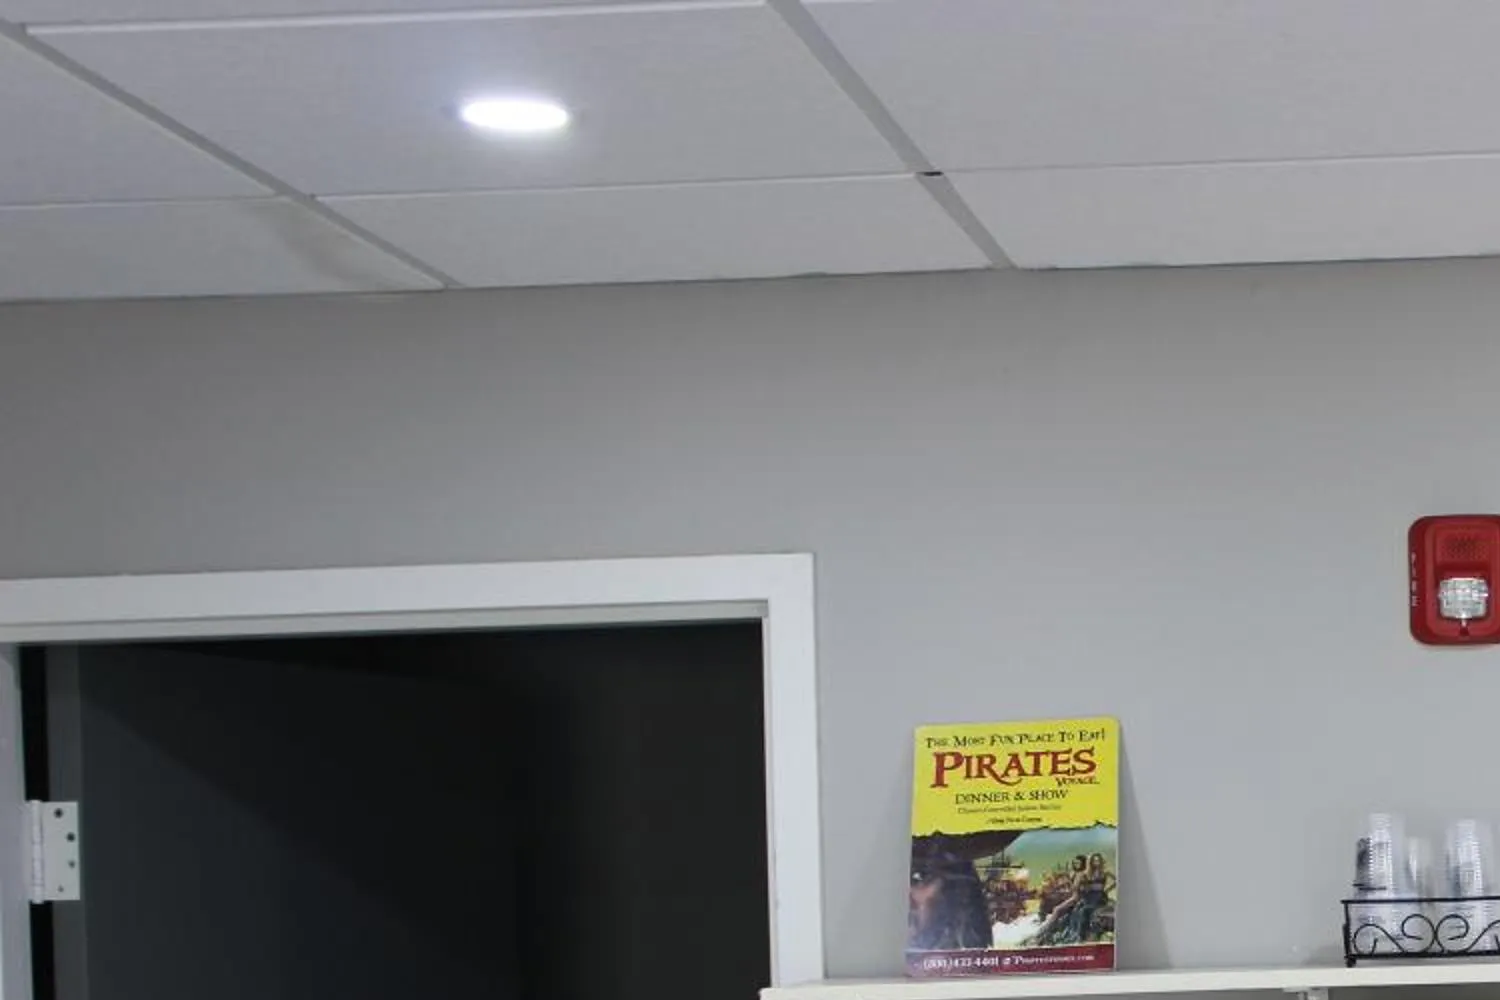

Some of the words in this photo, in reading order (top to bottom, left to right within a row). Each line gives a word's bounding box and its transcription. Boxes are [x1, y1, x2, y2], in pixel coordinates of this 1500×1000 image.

[931, 746, 1098, 788] PIRATES
[955, 792, 1010, 805] DINNER
[1014, 791, 1026, 802] &
[1028, 789, 1069, 801] SHOW
